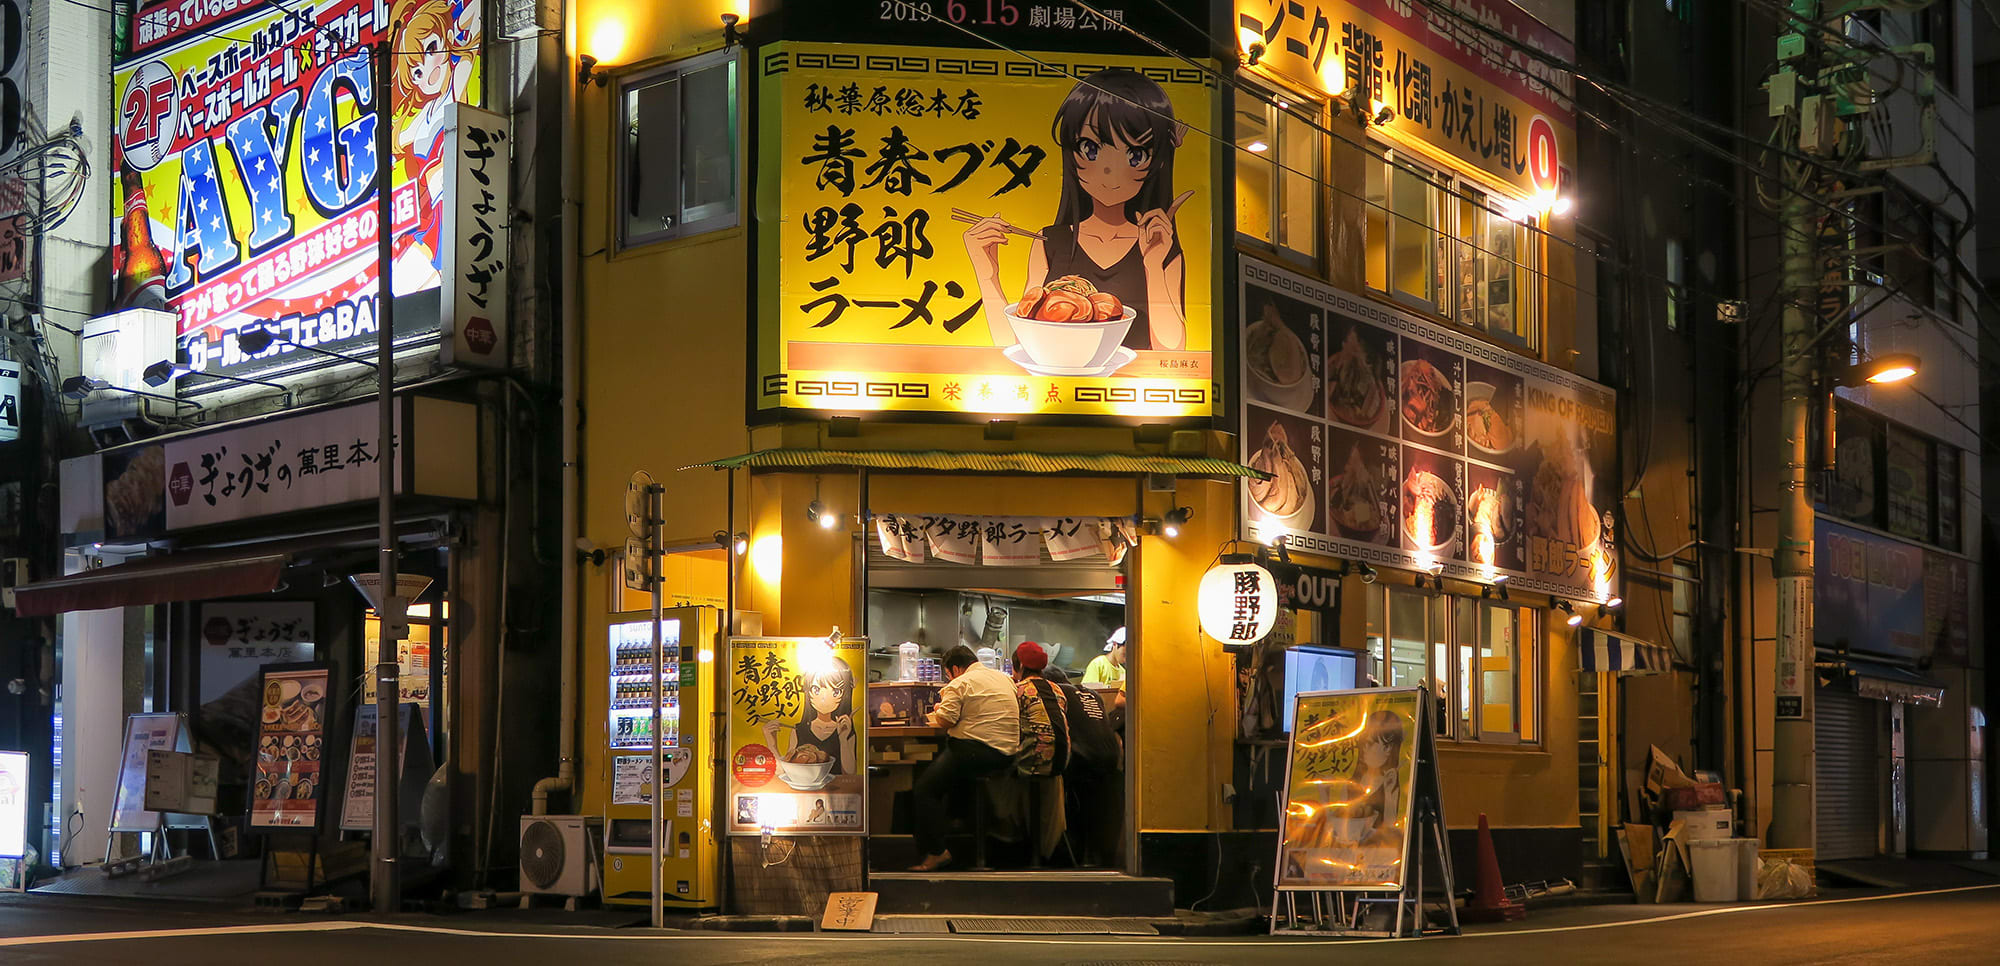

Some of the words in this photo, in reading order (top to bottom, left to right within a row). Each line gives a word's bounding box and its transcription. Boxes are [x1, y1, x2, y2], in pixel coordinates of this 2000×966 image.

[1029, 5, 1125, 32] 劇場公開
[179, 5, 318, 101] ベースボールカフェ
[124, 76, 175, 149] 2F
[803, 83, 984, 120] 秋葉原総本店
[166, 47, 379, 289] AYG
[801, 124, 1048, 198] 青春ブタ
[464, 125, 507, 309] ぎょうざ
[802, 203, 935, 279] 野郎
[800, 276, 984, 334] ラーメン
[1528, 386, 1556, 416] KING
[1558, 397, 1574, 420] OF
[1229, 571, 1261, 641] 豚野郎
[1297, 573, 1341, 608] OUT
[733, 674, 803, 711] ブタ野郎
[735, 651, 790, 685] 青春
[746, 701, 801, 727] ラーメン
